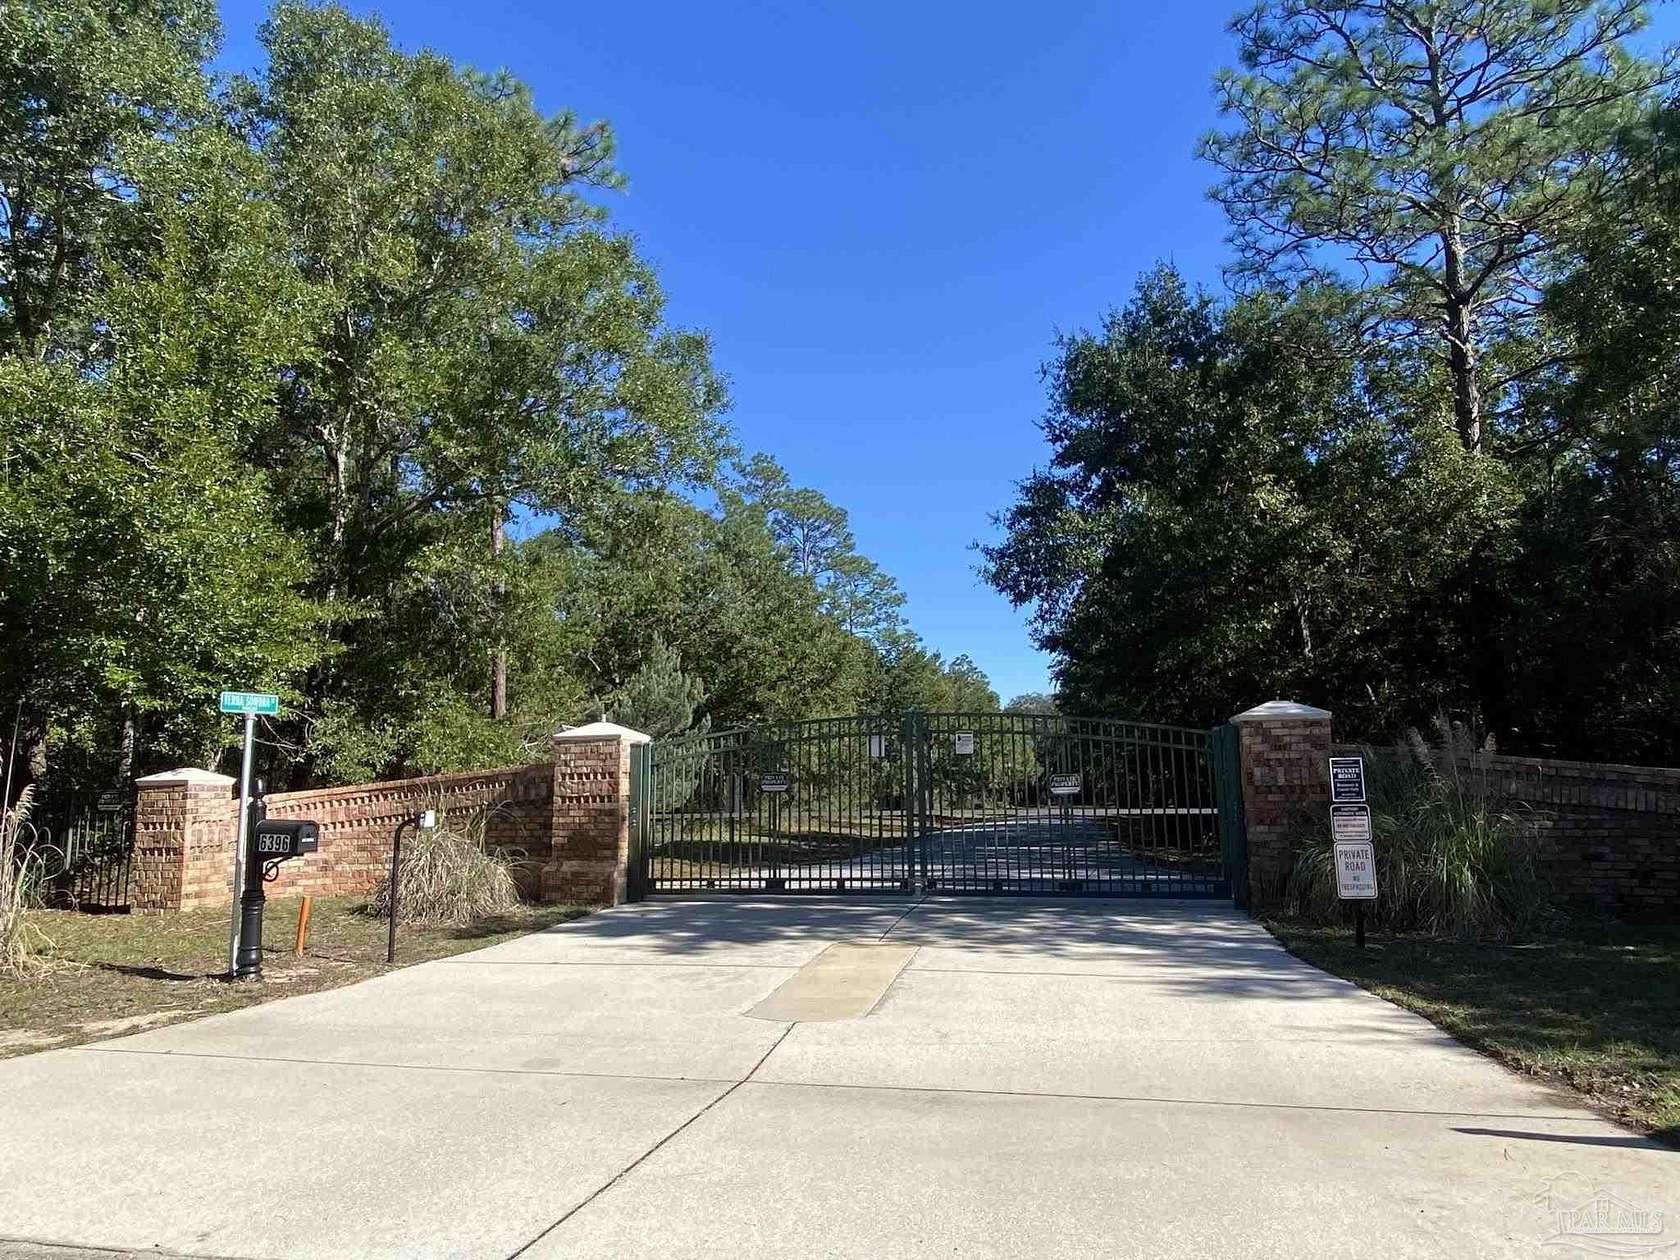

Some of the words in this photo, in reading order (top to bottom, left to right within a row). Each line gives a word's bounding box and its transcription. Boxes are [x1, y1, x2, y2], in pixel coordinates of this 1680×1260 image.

[260, 834, 289, 851] 6396
[1338, 849, 1370, 860] PRIVATE
[1344, 861, 1366, 871] ROAD
